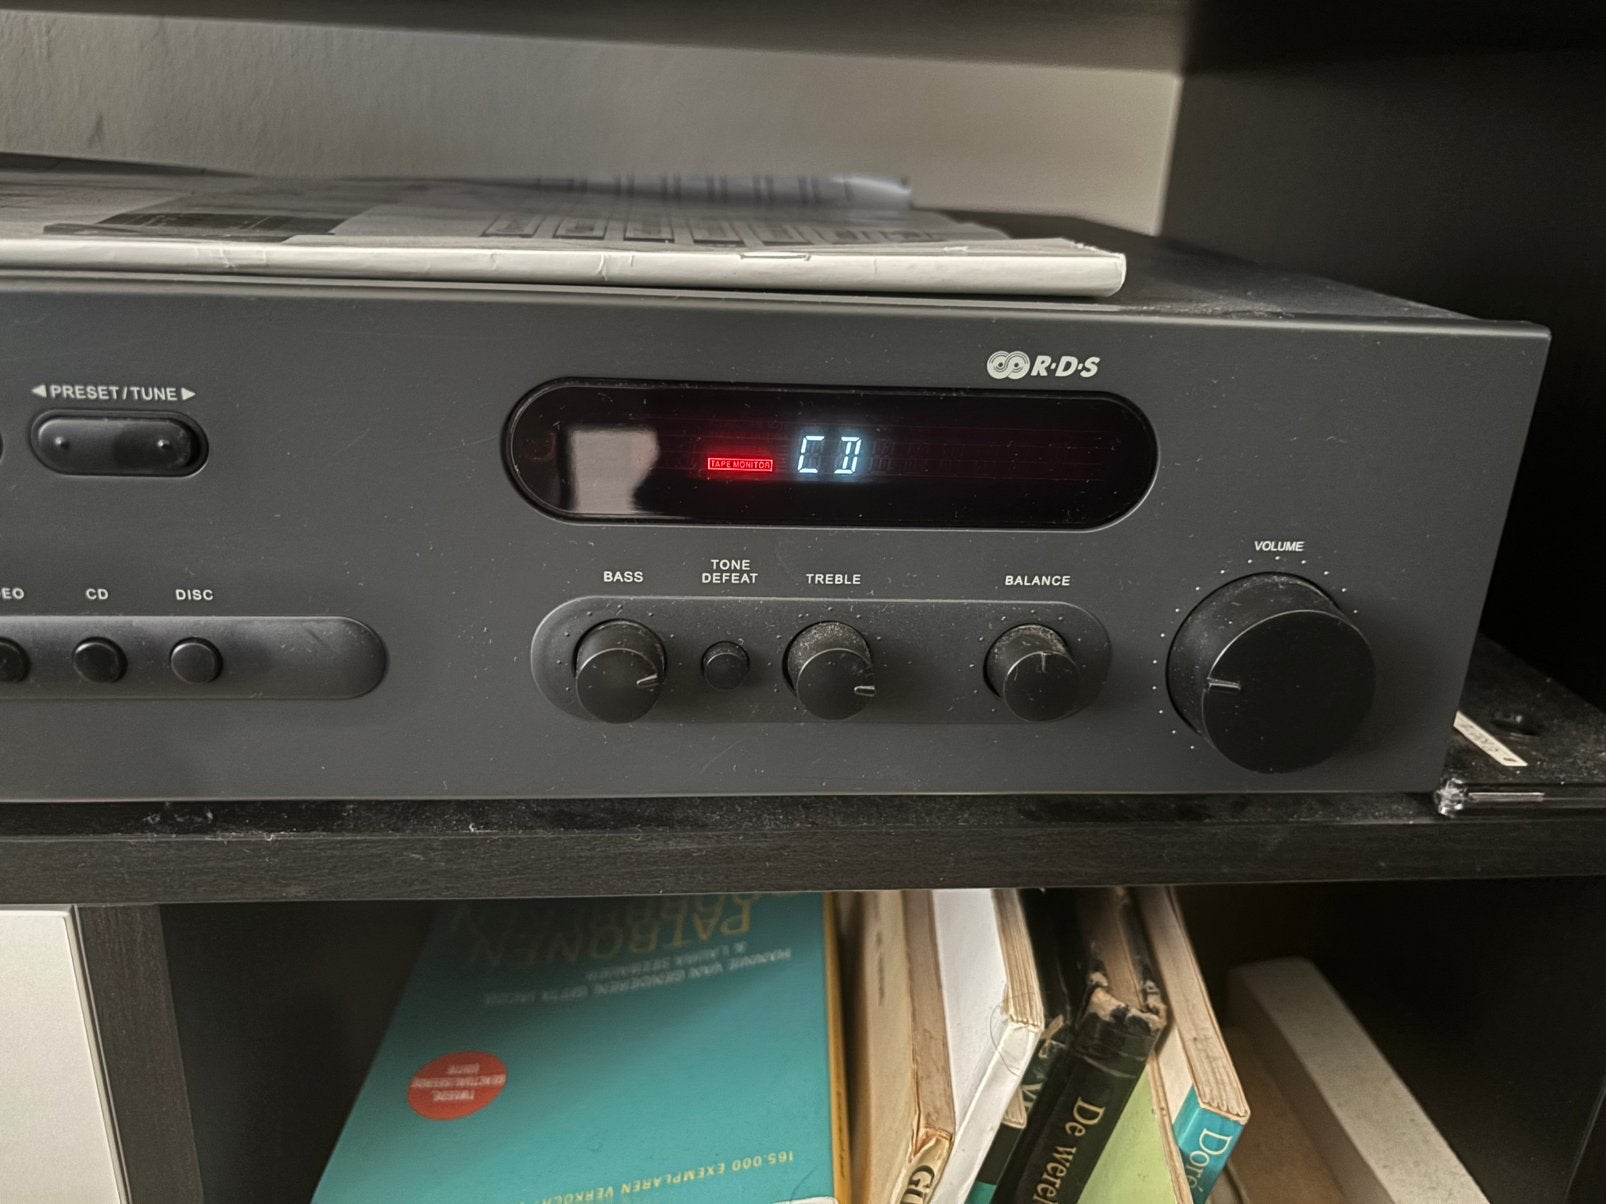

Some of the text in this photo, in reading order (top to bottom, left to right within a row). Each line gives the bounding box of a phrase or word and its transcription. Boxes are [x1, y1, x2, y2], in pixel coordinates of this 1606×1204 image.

[710, 460, 770, 470] TAPE MONITOR
[1254, 540, 1304, 552] VOLUME
[710, 559, 751, 571] TONE
[602, 570, 644, 583] BASS
[701, 573, 758, 585] DEFEAT
[806, 573, 861, 586] TREBLE
[1004, 575, 1071, 587] BALANCE
[0, 587, 25, 600] EO
[85, 588, 109, 601] CD
[175, 588, 214, 601] DISC
[1065, 1097, 1106, 1137] De
[731, 1150, 795, 1172] 165.000
[620, 1160, 727, 1195] EXEMPLAREN
